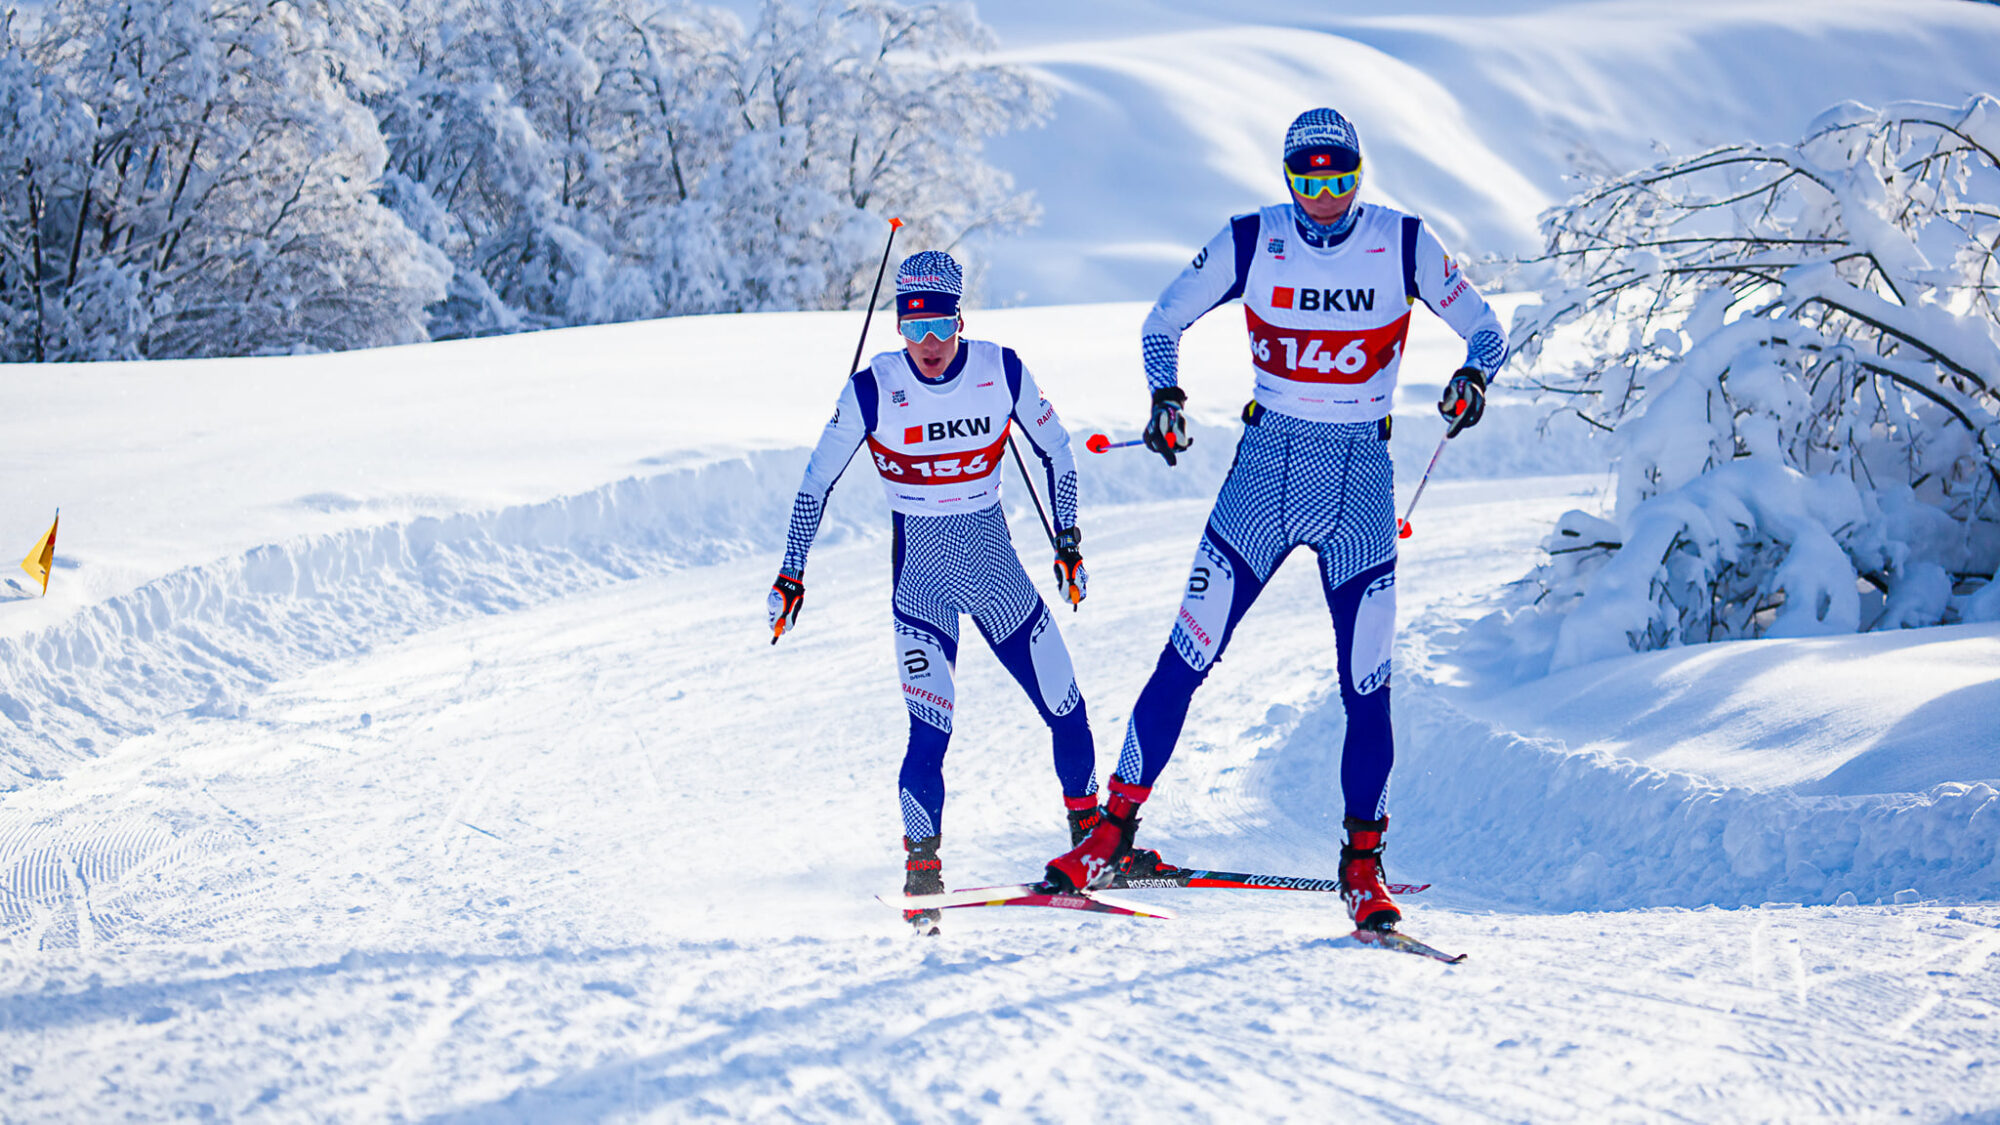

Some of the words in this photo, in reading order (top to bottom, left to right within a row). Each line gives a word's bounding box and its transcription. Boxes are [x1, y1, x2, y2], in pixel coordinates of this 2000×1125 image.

[1299, 288, 1375, 312] BKW
[1277, 337, 1367, 374] 146
[928, 417, 990, 441] BKW
[911, 453, 988, 477] 136
[902, 683, 953, 711] RAIFFEISEN
